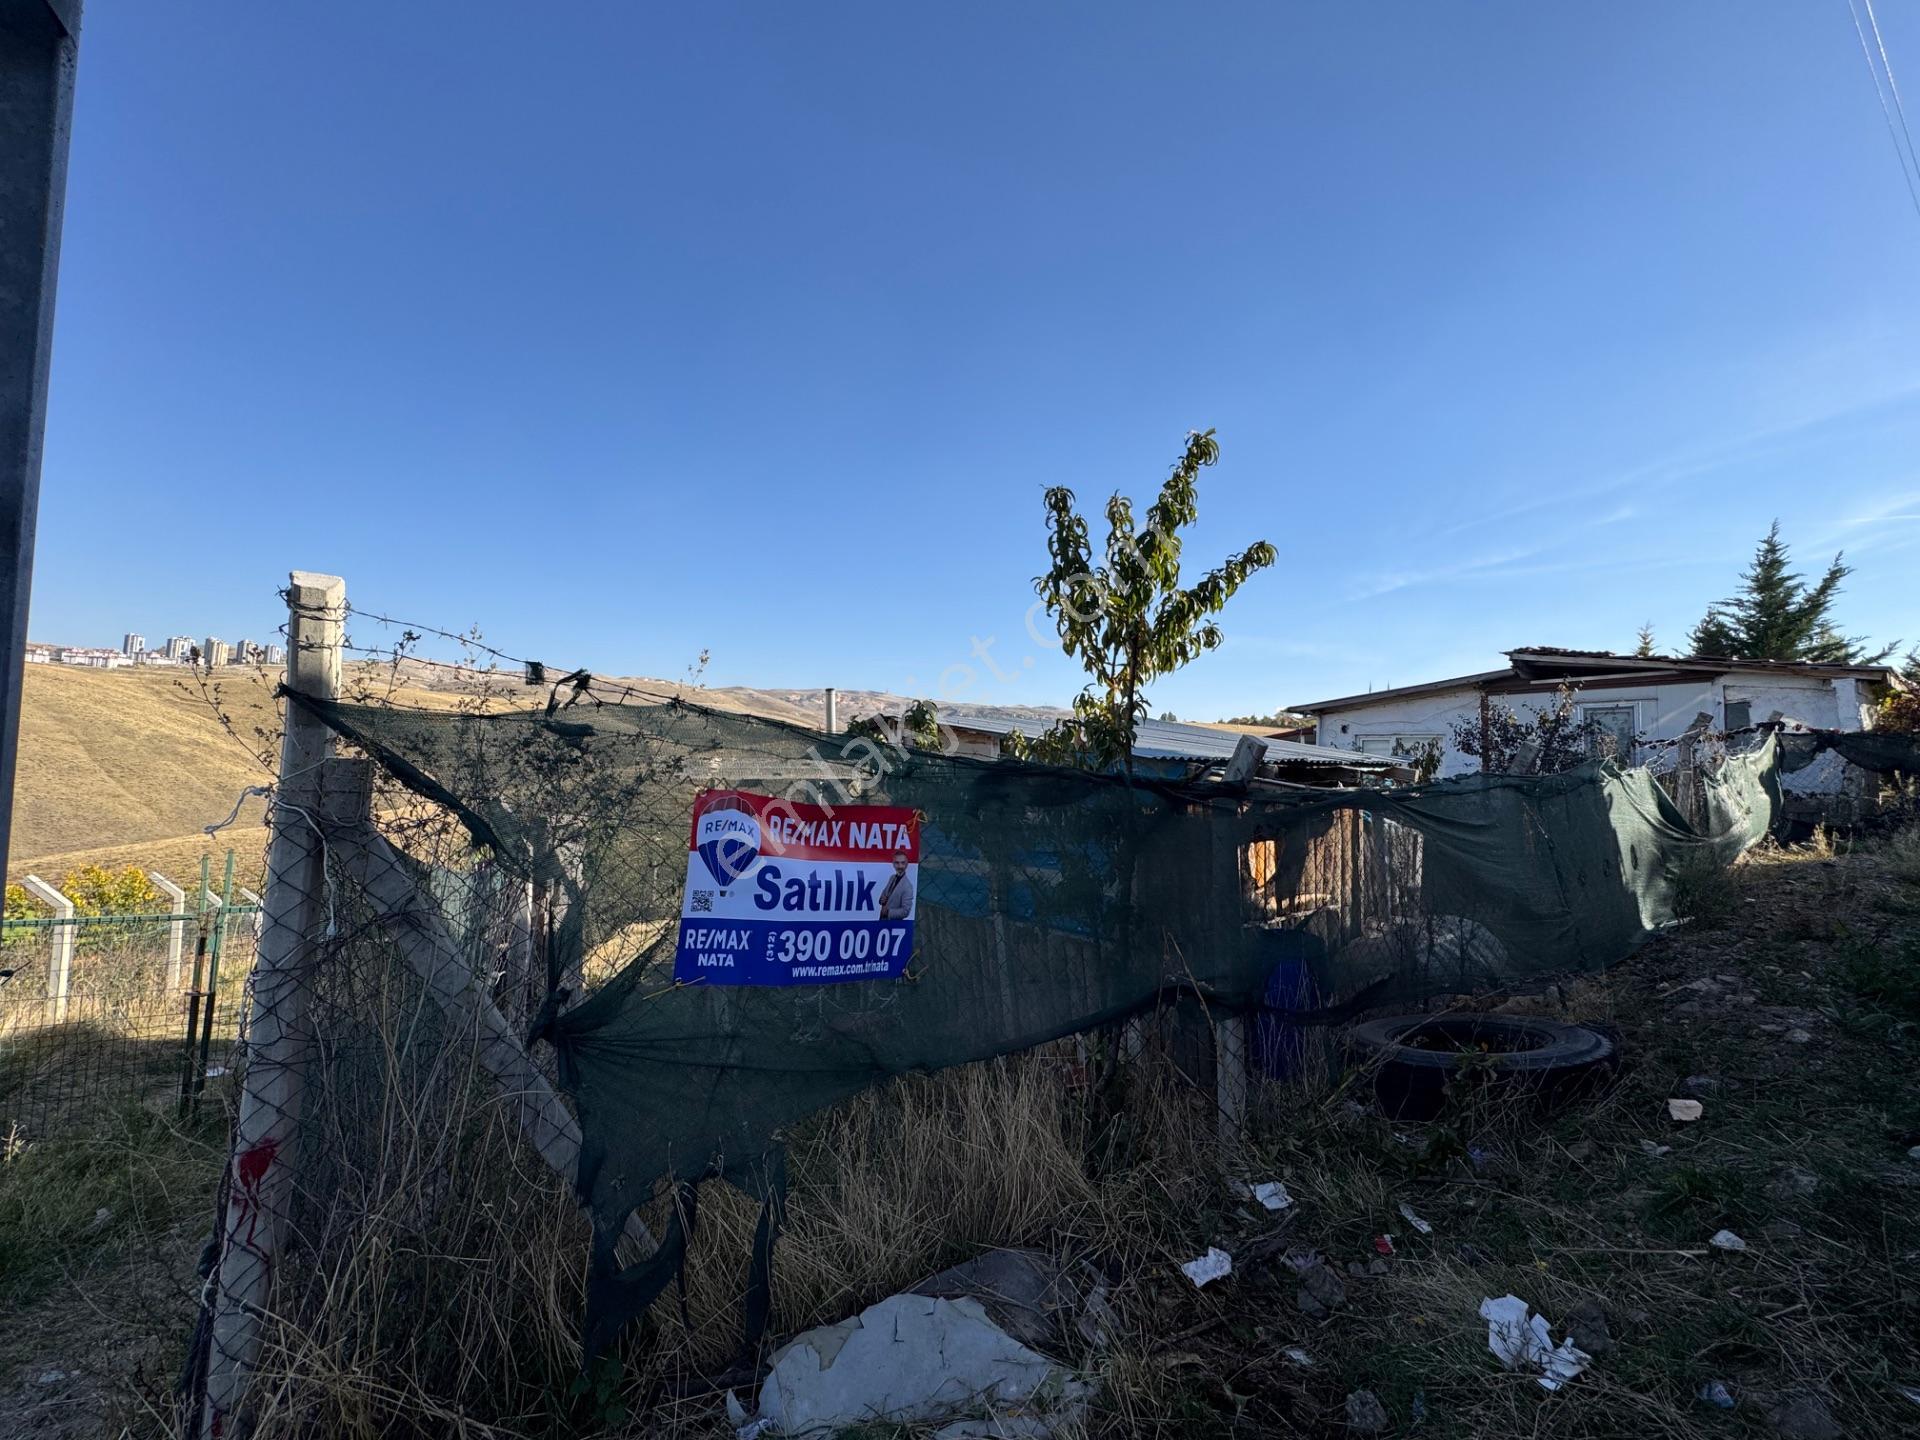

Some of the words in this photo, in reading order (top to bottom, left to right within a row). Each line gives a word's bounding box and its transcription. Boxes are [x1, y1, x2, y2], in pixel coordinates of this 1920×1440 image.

[704, 819, 755, 838] RE/MAX
[769, 815, 843, 848] RE/MAX
[848, 822, 912, 850] NATA
[753, 865, 877, 912] Satılık
[684, 929, 751, 951] RE/MAX
[765, 931, 778, 962] (312)
[777, 930, 832, 963] 390
[839, 929, 870, 959] 00
[875, 928, 907, 958] 07
[697, 953, 735, 968] NATA
